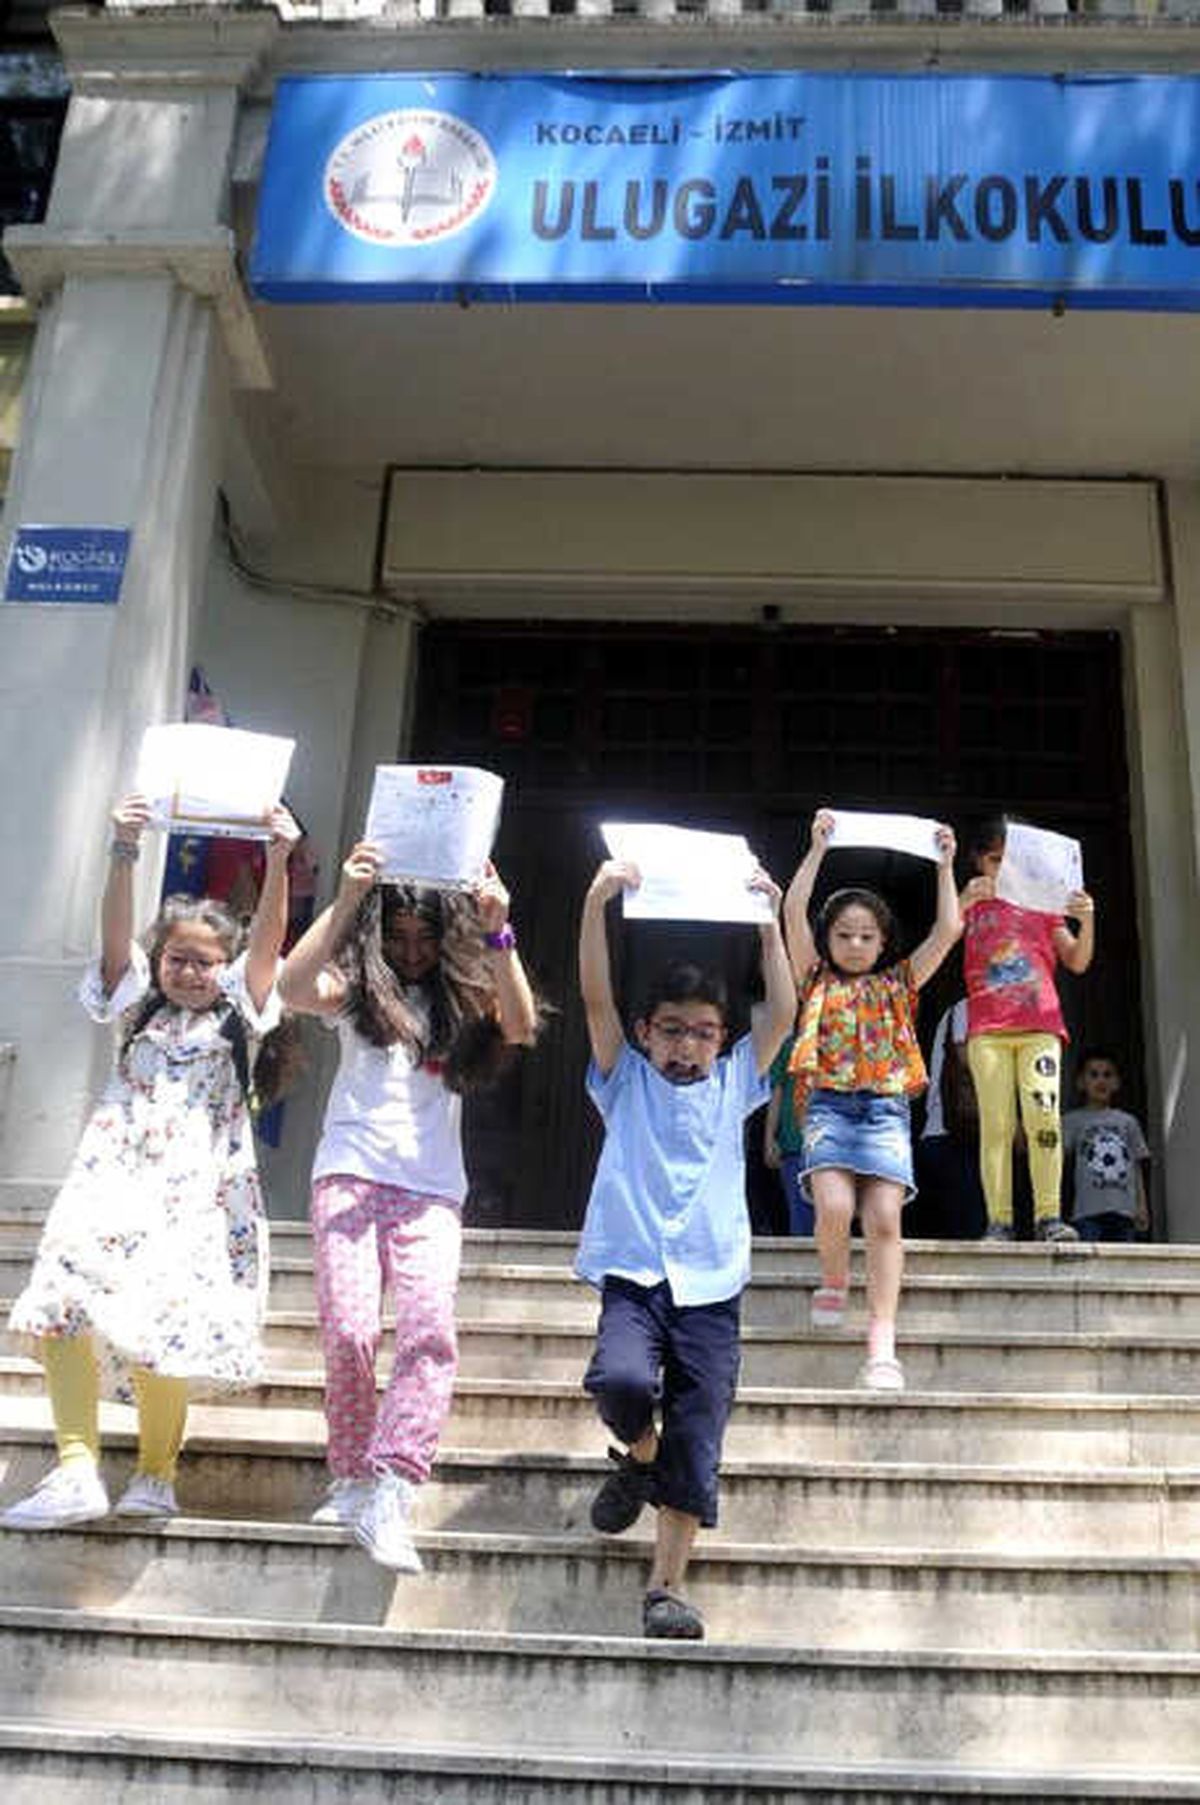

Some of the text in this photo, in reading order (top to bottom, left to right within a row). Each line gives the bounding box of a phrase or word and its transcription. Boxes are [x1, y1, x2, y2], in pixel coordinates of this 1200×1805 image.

[535, 116, 681, 145] KOCAELİ
[715, 111, 806, 144] İZMİT
[531, 155, 830, 242] ULUGAZİ
[855, 155, 1200, 247] İLKOKULU
